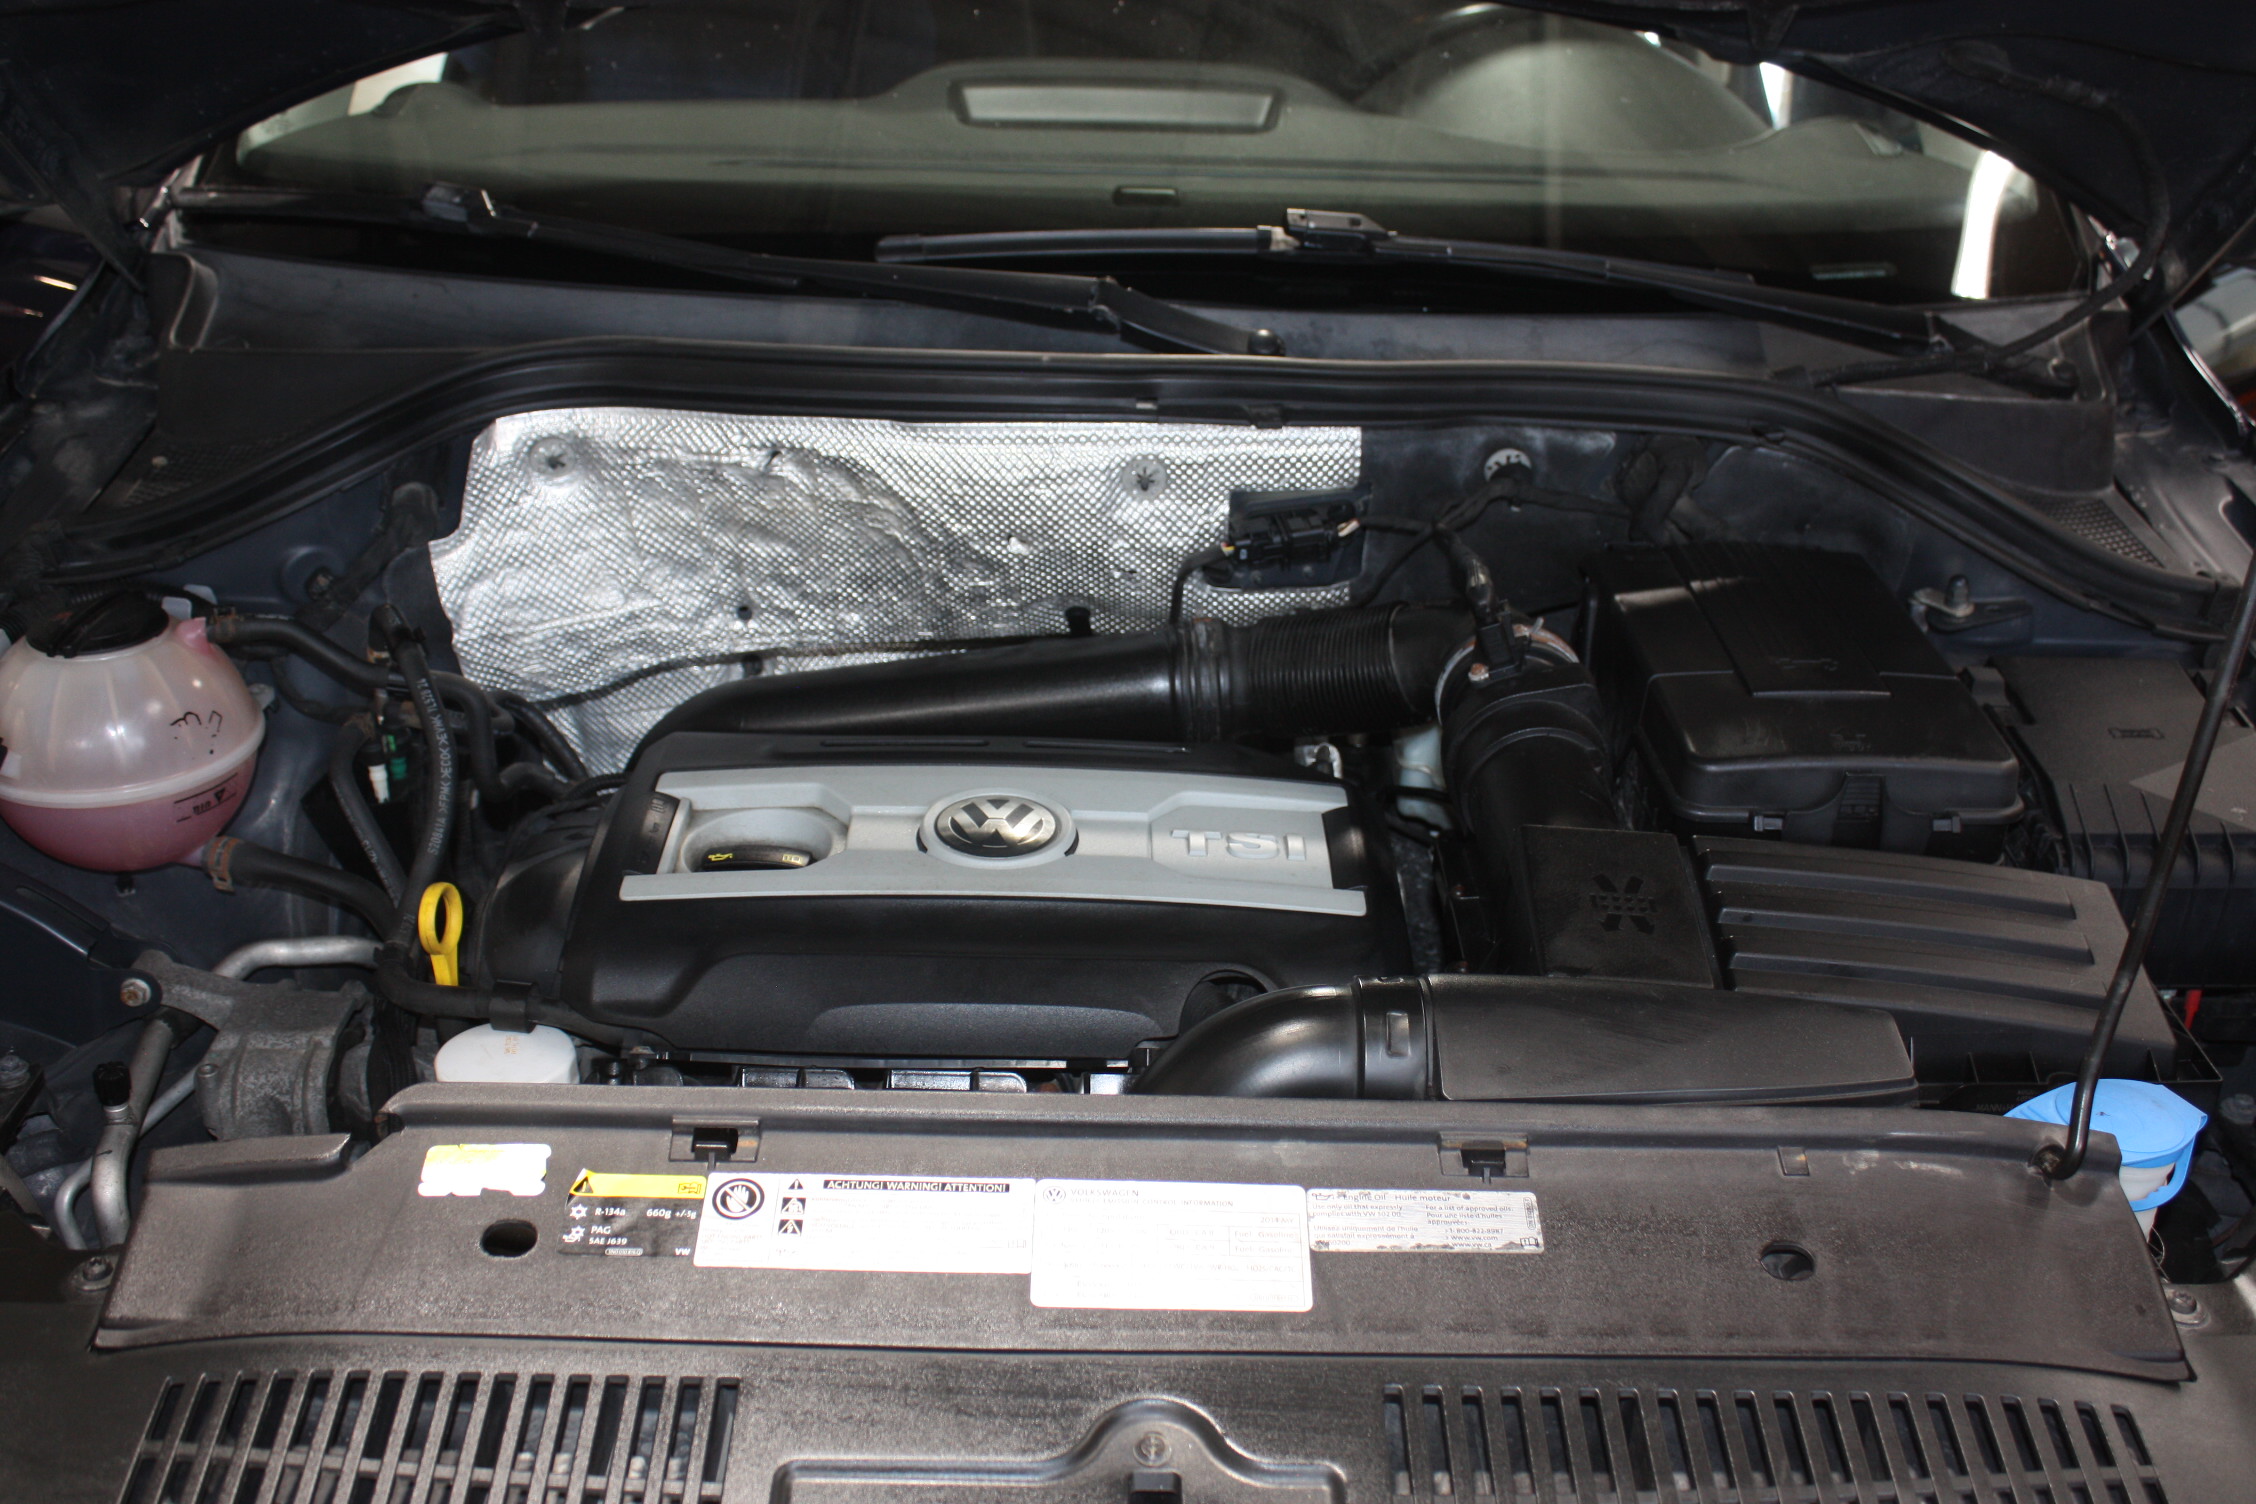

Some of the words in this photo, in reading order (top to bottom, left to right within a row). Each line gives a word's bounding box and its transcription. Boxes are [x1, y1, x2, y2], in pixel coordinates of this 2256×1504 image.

[1170, 829, 1307, 861] TSI
[827, 1180, 884, 1190] ACHTUNG!
[886, 1181, 942, 1191] WARNING!
[944, 1183, 1007, 1193] ATTENTION!
[1070, 1188, 1140, 1198] VOLKSWAGEN
[1373, 1193, 1386, 1201] Oil
[1395, 1194, 1417, 1202] Huile
[594, 1207, 626, 1217] R-134a
[1370, 1204, 1403, 1212] expressly
[1465, 1205, 1498, 1213] approved
[646, 1208, 672, 1220] 660g
[590, 1225, 612, 1234] PAG
[589, 1237, 606, 1245] SAE
[675, 1247, 691, 1257] VW
